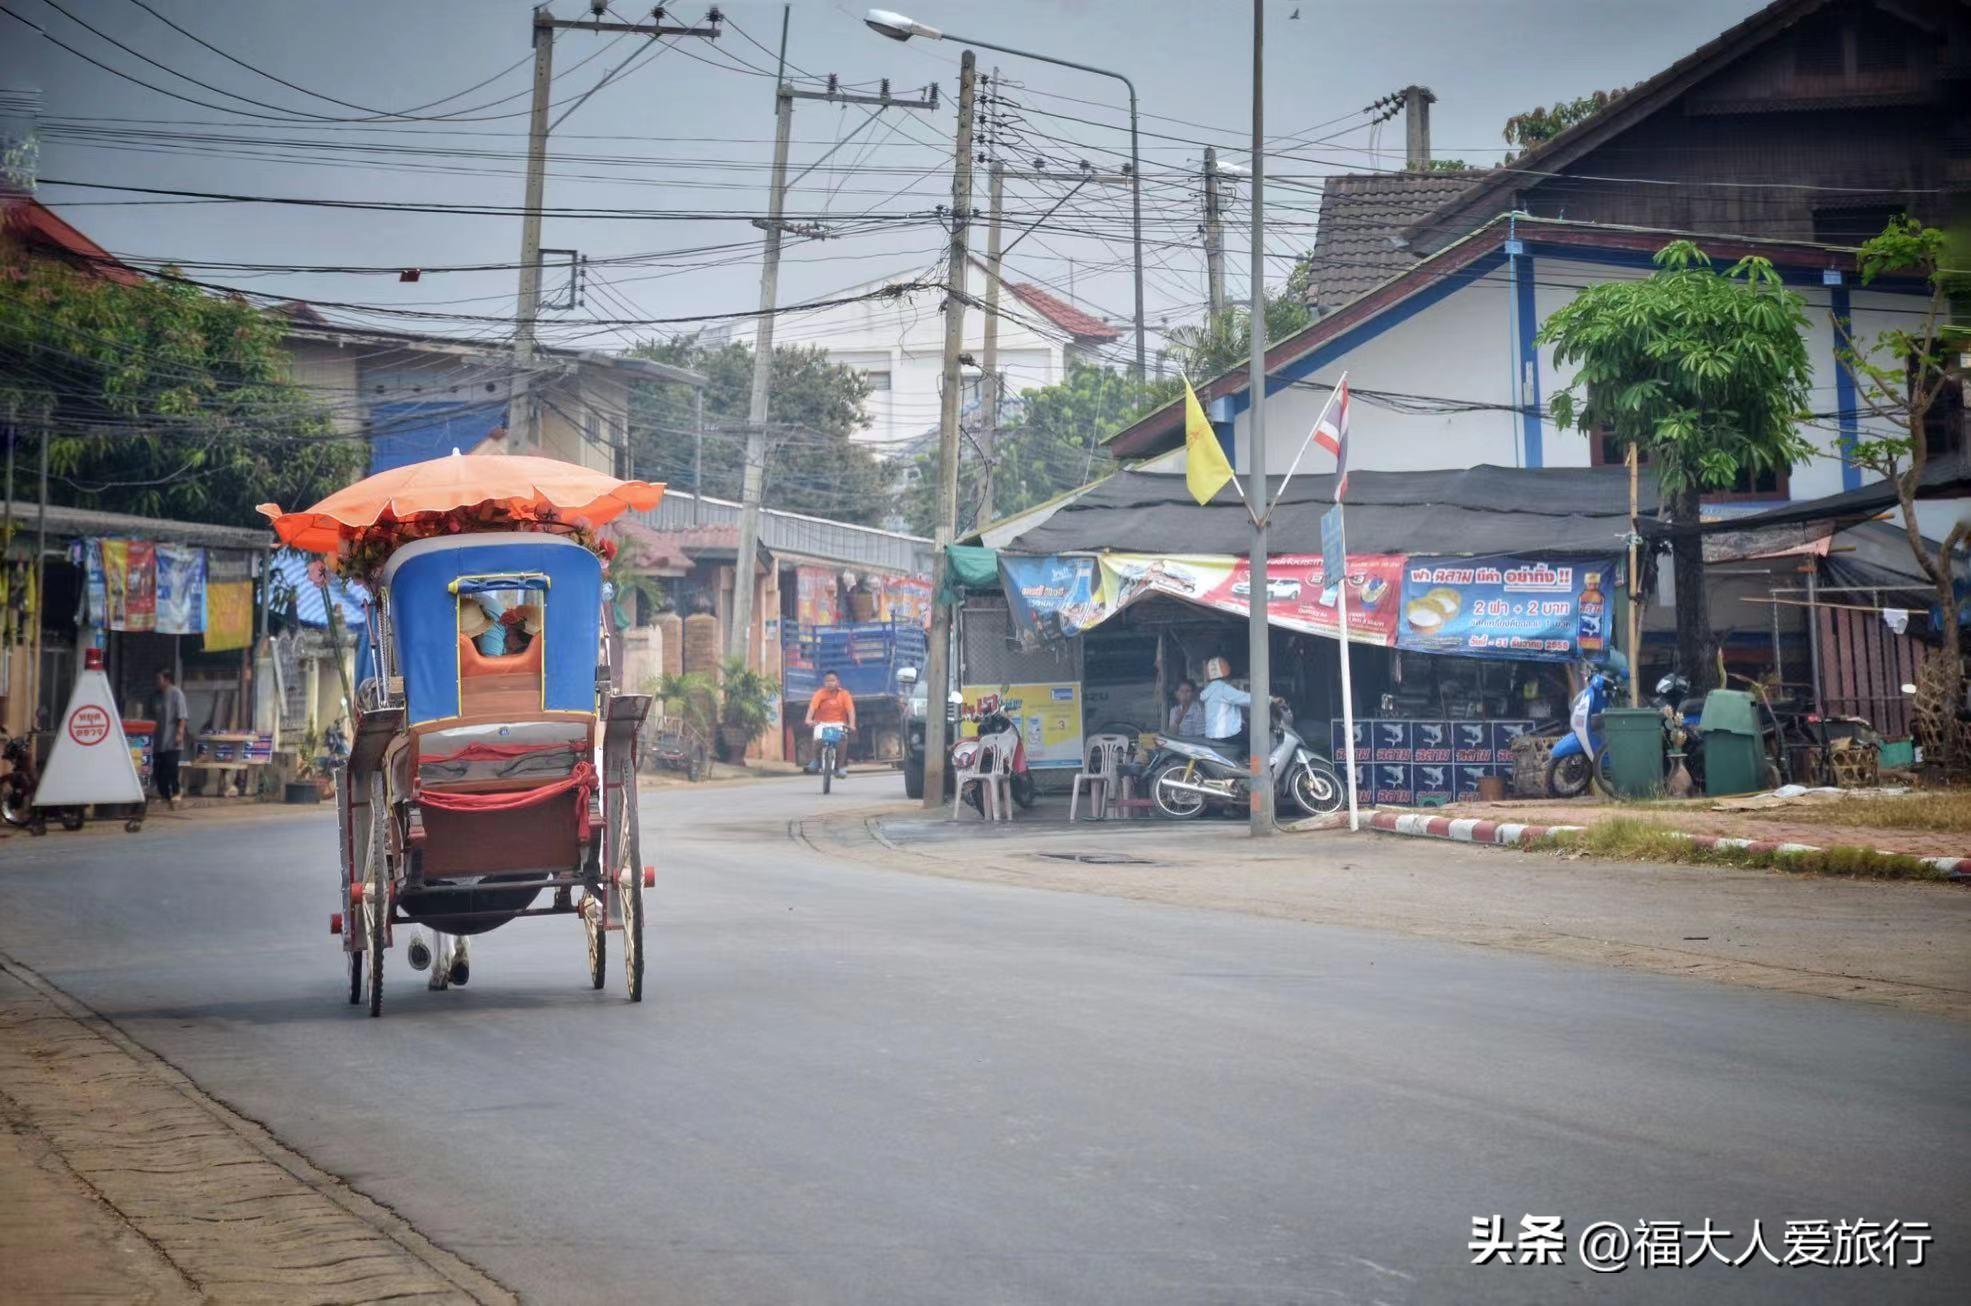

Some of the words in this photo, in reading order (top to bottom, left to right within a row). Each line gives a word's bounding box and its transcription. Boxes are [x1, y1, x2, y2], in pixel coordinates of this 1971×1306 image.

[1434, 569, 1473, 584] ฉลาม
[1473, 600, 1484, 615] 2
[1527, 600, 1539, 615] 2
[1376, 748, 1411, 761] ฉลาม
[1415, 748, 1451, 761] ฉลาม
[1456, 749, 1492, 762] ฉลาม
